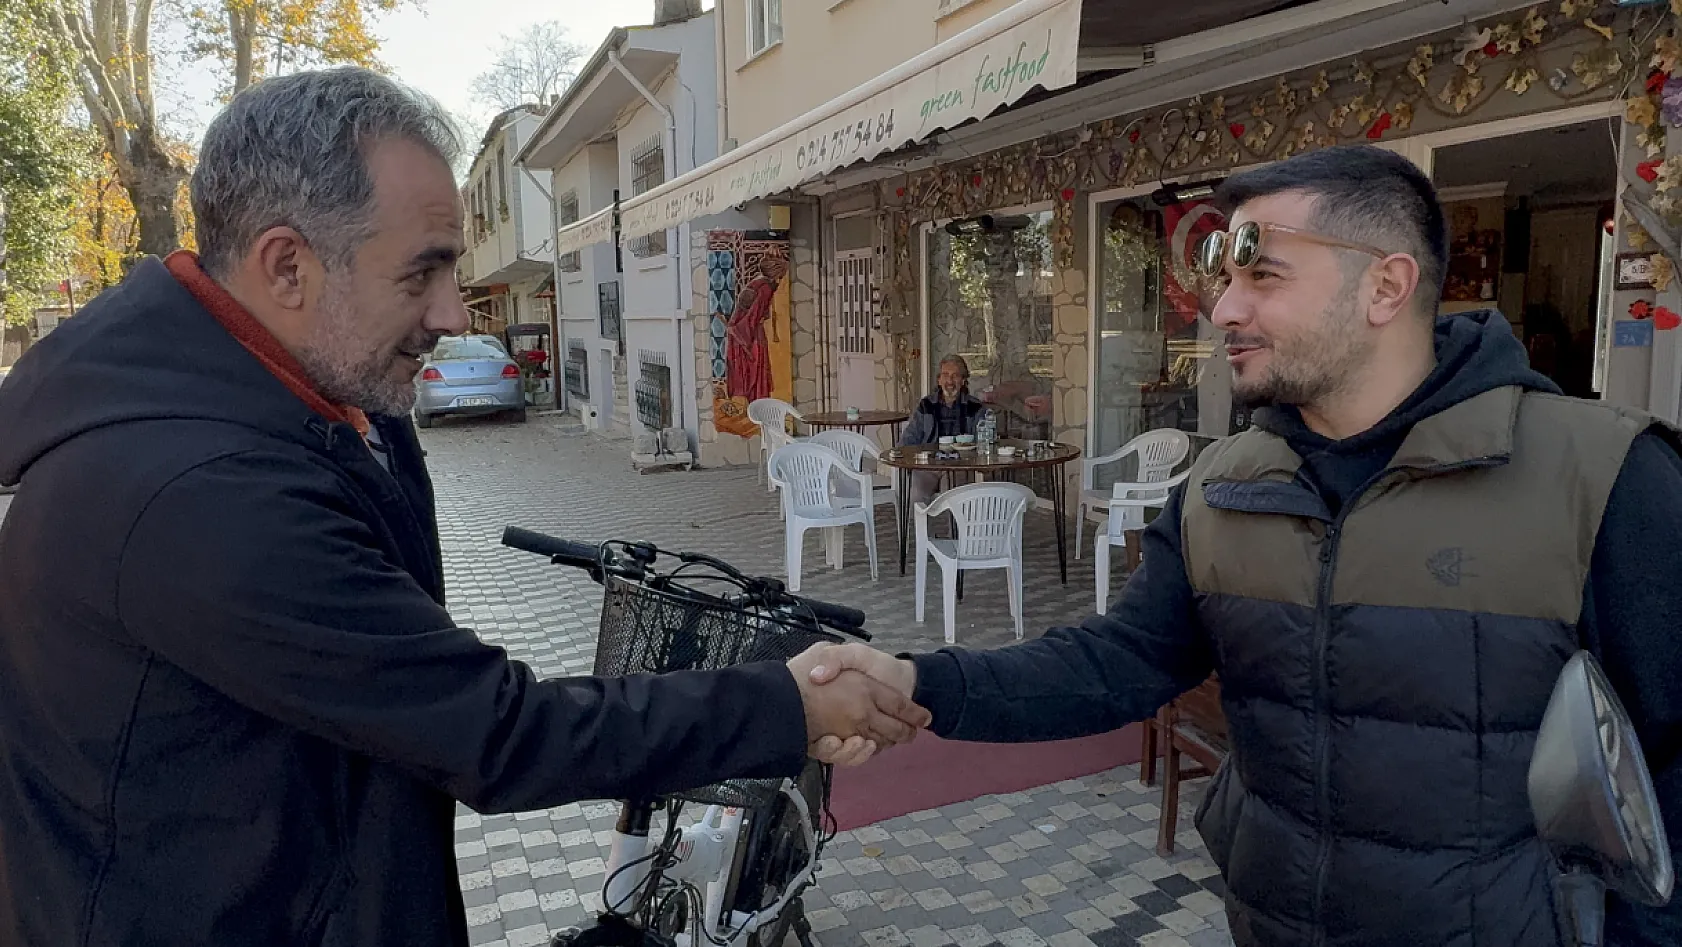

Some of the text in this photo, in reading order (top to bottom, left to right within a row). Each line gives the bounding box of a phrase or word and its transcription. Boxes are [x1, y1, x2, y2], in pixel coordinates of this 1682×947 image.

[919, 28, 1052, 132] green fastfood
[852, 118, 872, 154] 54
[876, 109, 895, 142] 84
